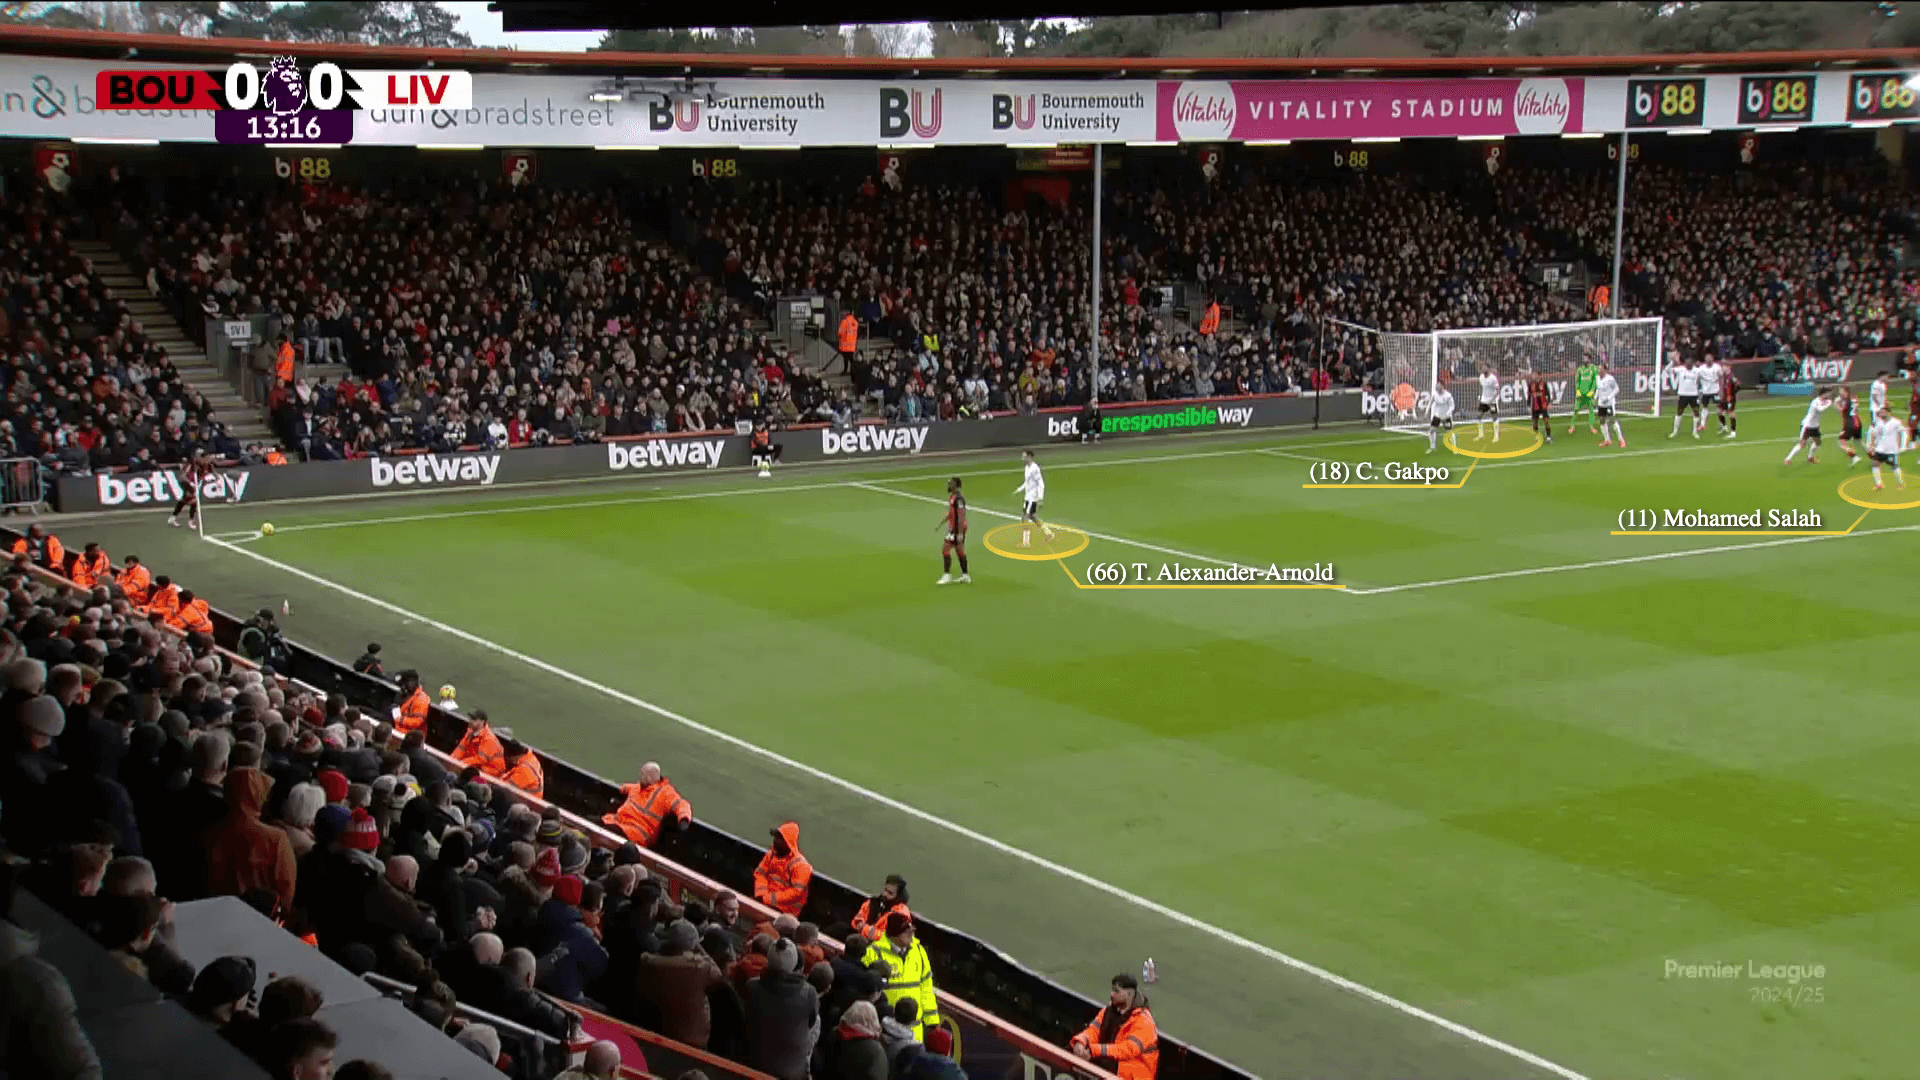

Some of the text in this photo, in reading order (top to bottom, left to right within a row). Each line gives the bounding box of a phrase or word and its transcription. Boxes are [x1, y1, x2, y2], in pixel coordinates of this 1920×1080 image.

[465, 98, 614, 127] bradstreet
[880, 87, 943, 138] BU
[992, 93, 1036, 130] BU
[1042, 92, 1144, 109] Bournemouth
[1176, 91, 1234, 131] Vitality
[1250, 98, 1503, 120] VITALITY STADIUM
[1517, 87, 1569, 125] Vitality
[707, 114, 798, 136] University
[1042, 113, 1120, 133] University
[608, 439, 725, 470] betway
[822, 425, 929, 454] betway
[370, 453, 500, 486] betway
